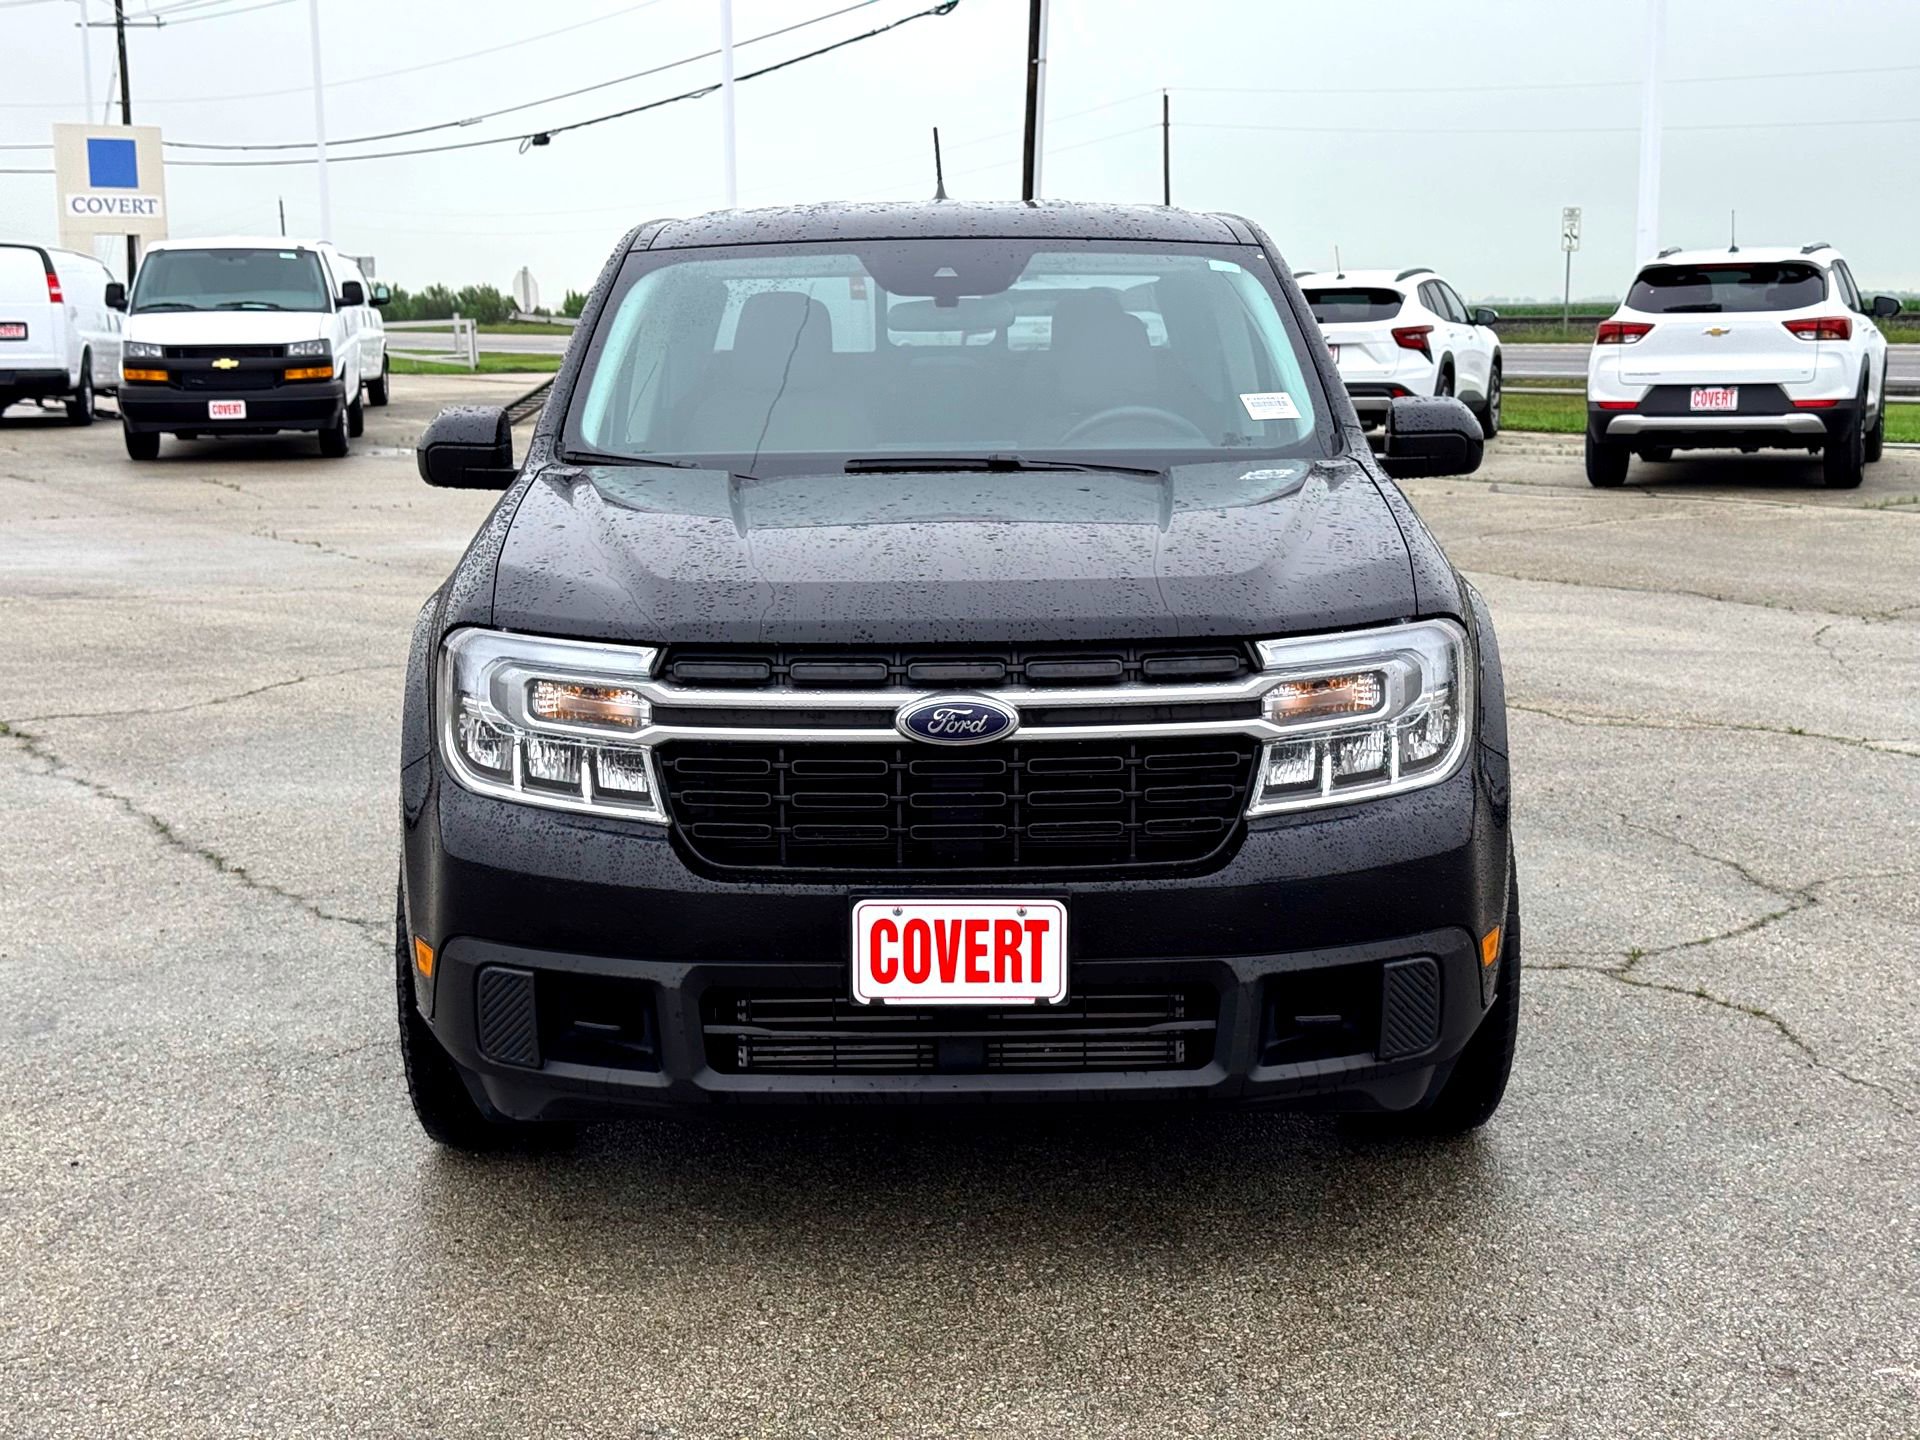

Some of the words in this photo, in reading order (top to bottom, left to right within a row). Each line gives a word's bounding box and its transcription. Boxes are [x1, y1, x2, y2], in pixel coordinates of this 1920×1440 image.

[72, 197, 158, 214] COVERT
[1694, 390, 1735, 406] COVERT
[927, 708, 988, 733] Ford
[869, 918, 1050, 984] COVERT
